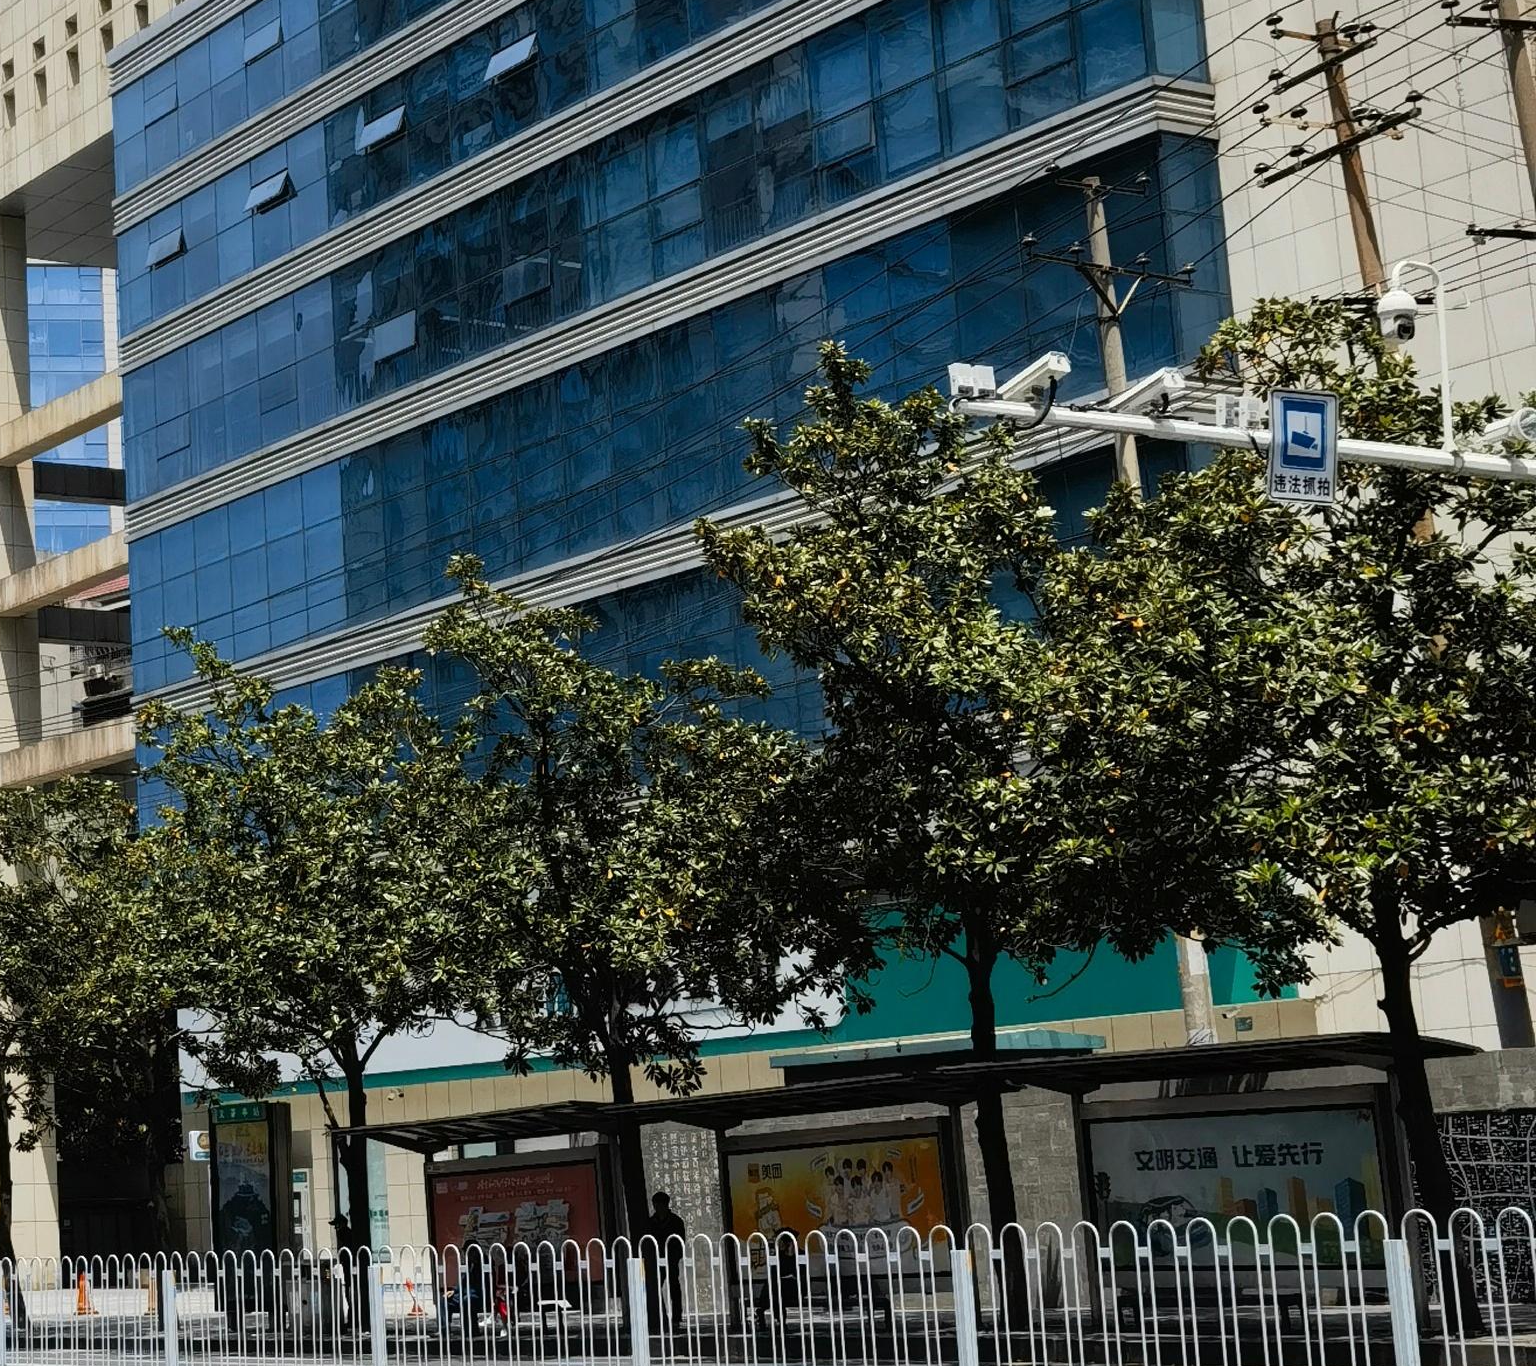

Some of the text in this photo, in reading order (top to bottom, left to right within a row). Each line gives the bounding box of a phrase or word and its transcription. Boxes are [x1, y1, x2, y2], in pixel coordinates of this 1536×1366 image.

[1273, 473, 1331, 497] 违法抓拍
[1133, 1141, 1325, 1172] 文明交通 让爱先行
